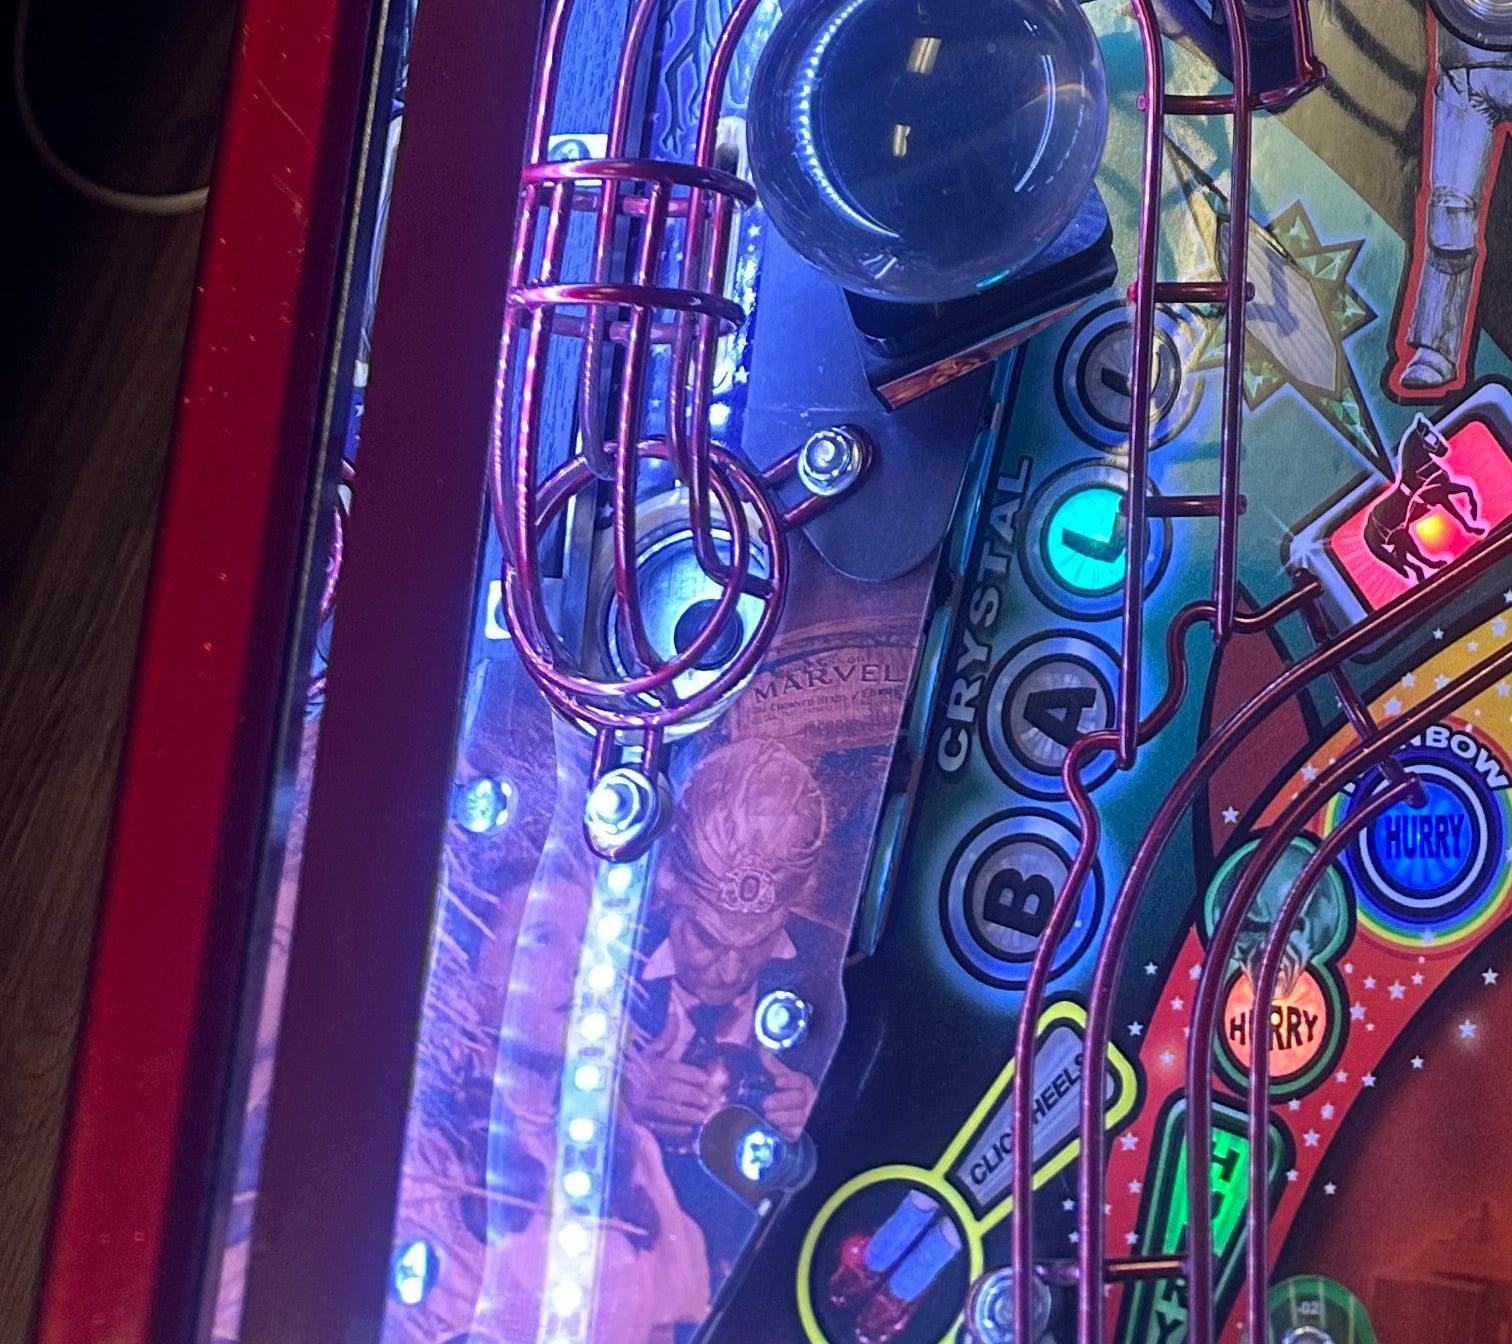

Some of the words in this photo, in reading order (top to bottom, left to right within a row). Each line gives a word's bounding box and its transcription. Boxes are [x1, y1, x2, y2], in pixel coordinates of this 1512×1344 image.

[936, 456, 1033, 773] CRYSTAL
[753, 663, 905, 704] MARVEL
[1384, 813, 1465, 860] HURRY
[1229, 1005, 1319, 1052] HRRY
